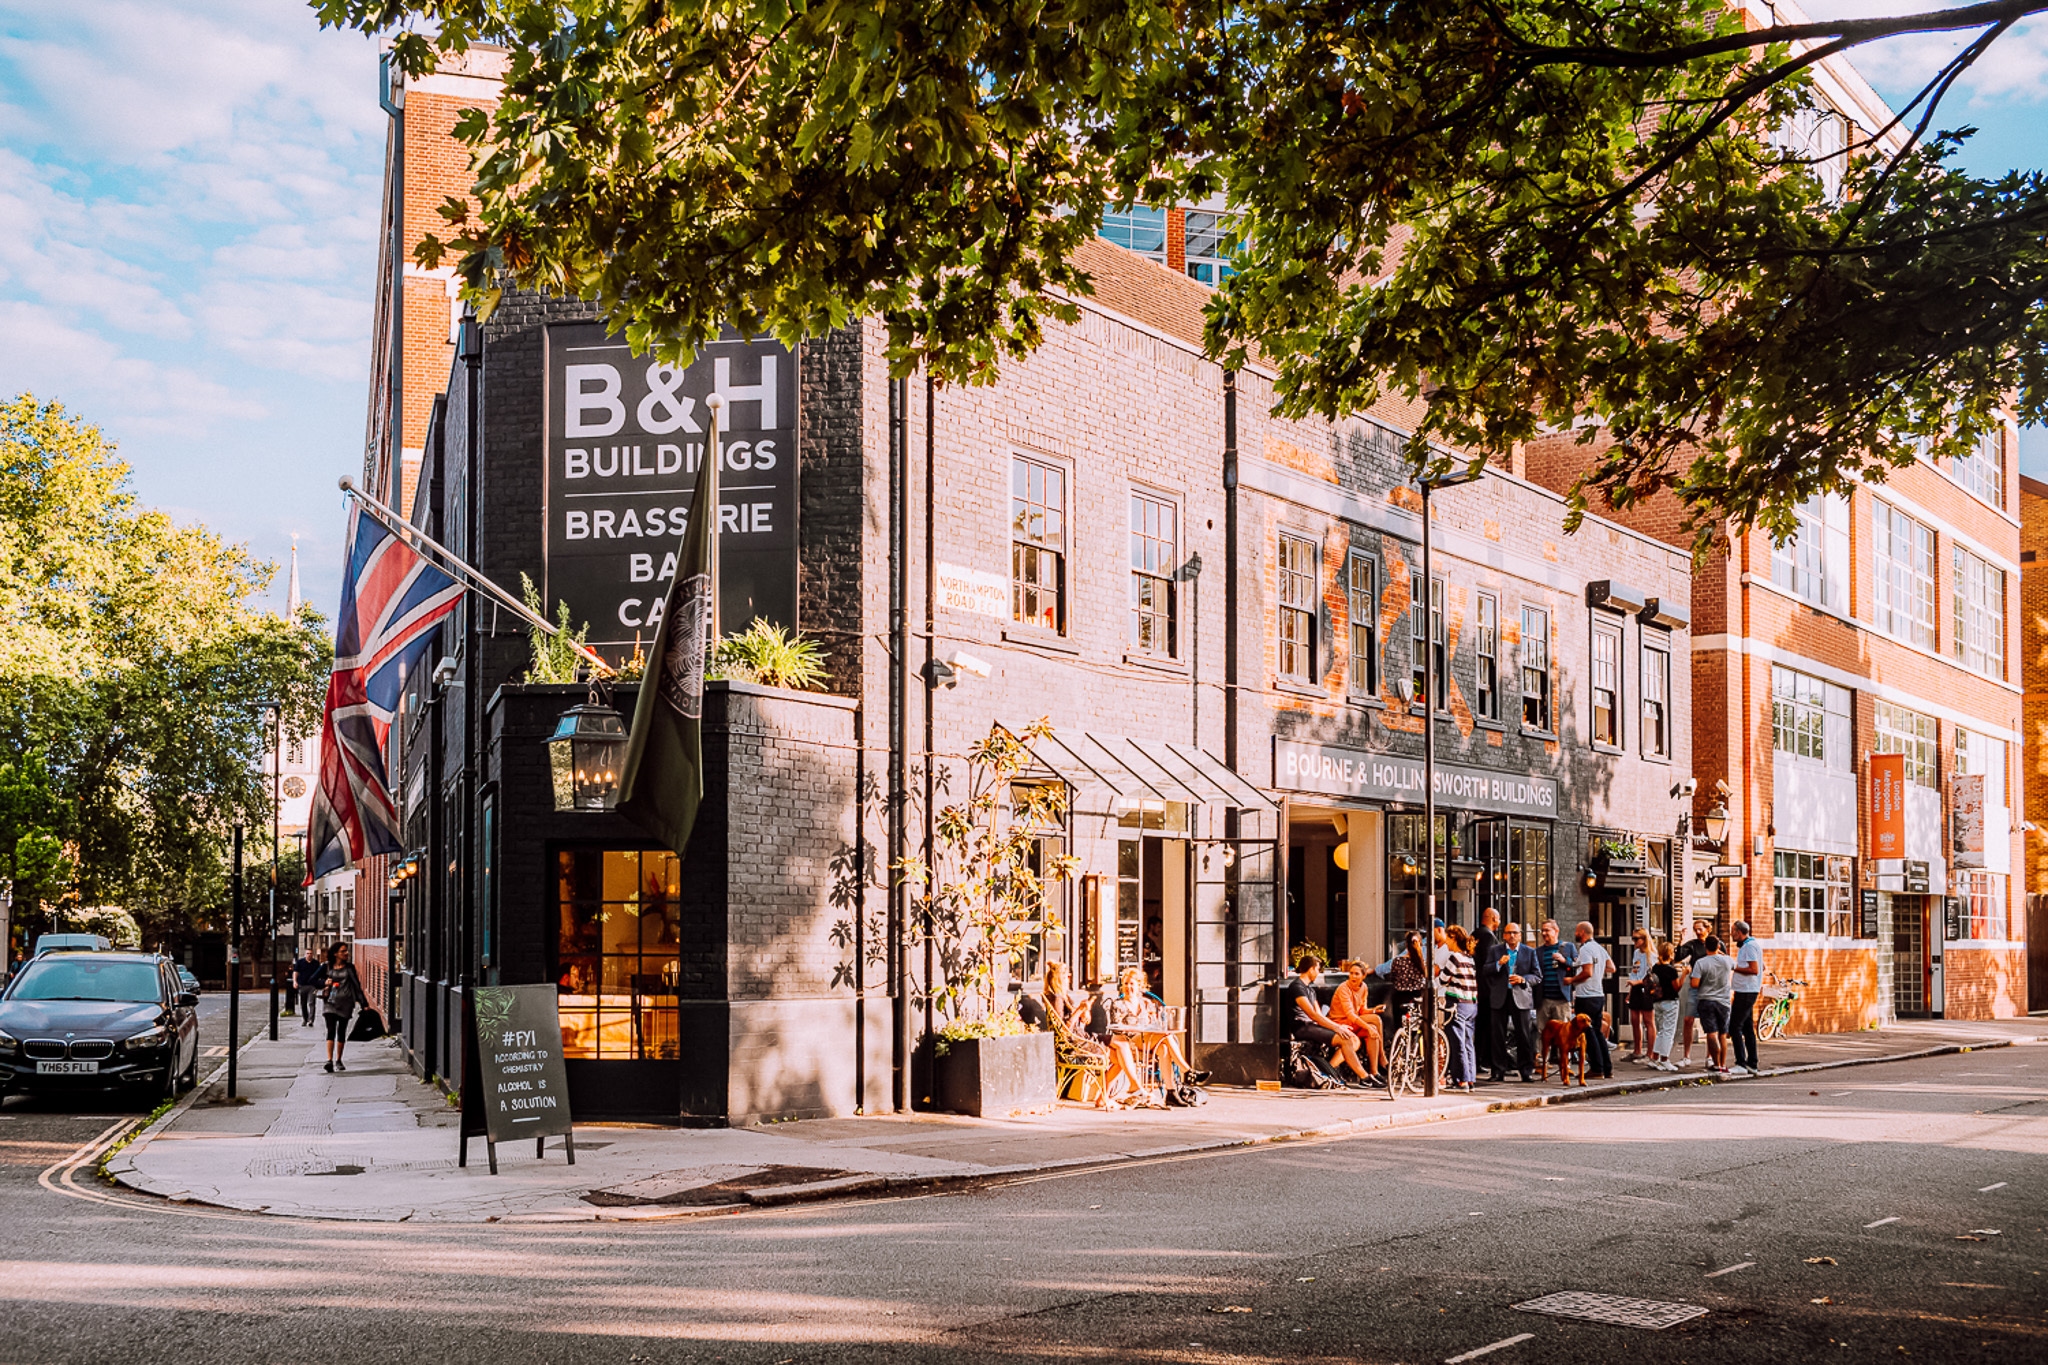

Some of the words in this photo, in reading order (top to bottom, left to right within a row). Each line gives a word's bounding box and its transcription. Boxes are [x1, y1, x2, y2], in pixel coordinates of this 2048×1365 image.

[565, 355, 778, 438] B&H
[566, 503, 773, 540] BRASSRIE
[630, 552, 678, 583] BA
[940, 576, 1005, 601] NORTHAMPTON
[1286, 751, 1353, 782] BOURNE
[1358, 761, 1368, 784] &
[1372, 762, 1489, 800] HOLLINSWORTH
[1492, 780, 1552, 807] BUILDINGS
[1874, 778, 1882, 813] Archives
[1884, 770, 1892, 821] Metropolitan
[1894, 780, 1902, 810] London
[502, 1030, 536, 1047] #FYI
[42, 1063, 69, 1072] YH65
[72, 1063, 93, 1072] FLL
[495, 1050, 535, 1064] ACCORDING
[537, 1050, 548, 1060] TO
[502, 1063, 544, 1074] CHEMISTRY
[498, 1081, 532, 1093] ALCOHOL
[538, 1080, 546, 1089] IS
[500, 1099, 508, 1112] A
[511, 1096, 556, 1111] SOLUTION
